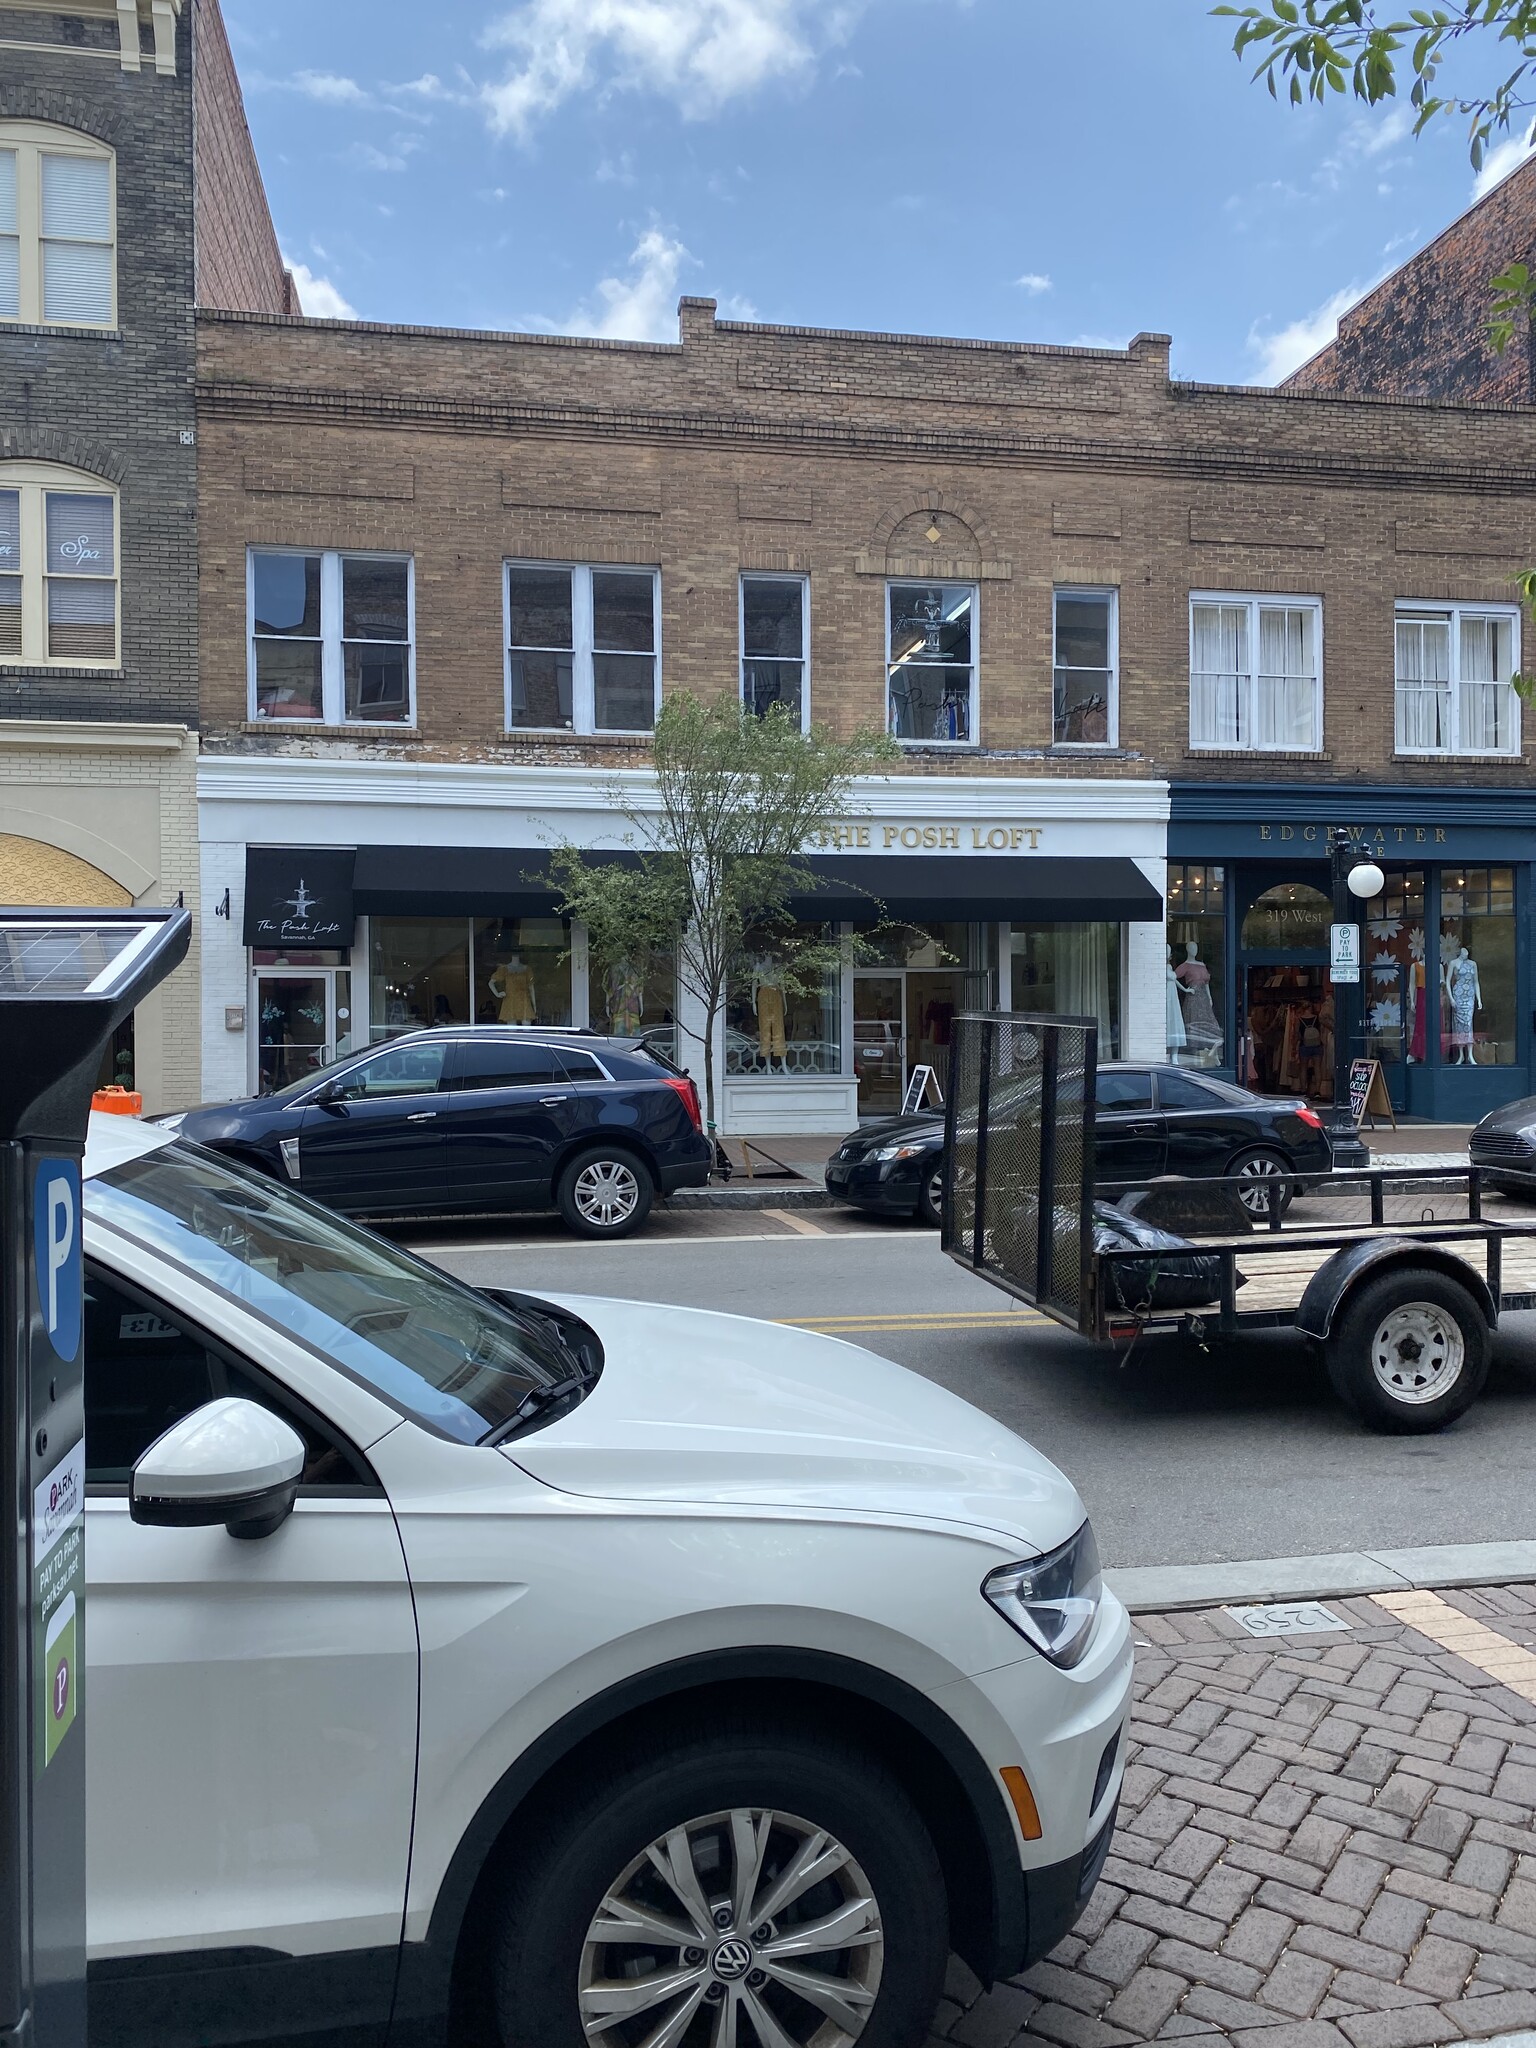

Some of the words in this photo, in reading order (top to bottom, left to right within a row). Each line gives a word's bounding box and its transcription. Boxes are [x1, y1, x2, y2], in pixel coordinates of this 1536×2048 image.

[60, 535, 101, 565] Spa
[882, 825, 960, 848] POSH
[972, 827, 1043, 849] LOFT
[1259, 825, 1447, 843] EDGEWATER
[257, 919, 277, 932] The
[281, 919, 311, 934] Posh
[312, 921, 341, 934] Loft
[1265, 909, 1288, 923] 319
[1291, 909, 1323, 923] West
[48, 1176, 74, 1334] P
[50, 1467, 74, 1509] PARK
[39, 1566, 54, 1593] PAY
[53, 1549, 63, 1574] TO
[63, 1526, 80, 1557] PARK
[41, 1553, 79, 1622] parksav.net
[1242, 1608, 1338, 1631] 1259
